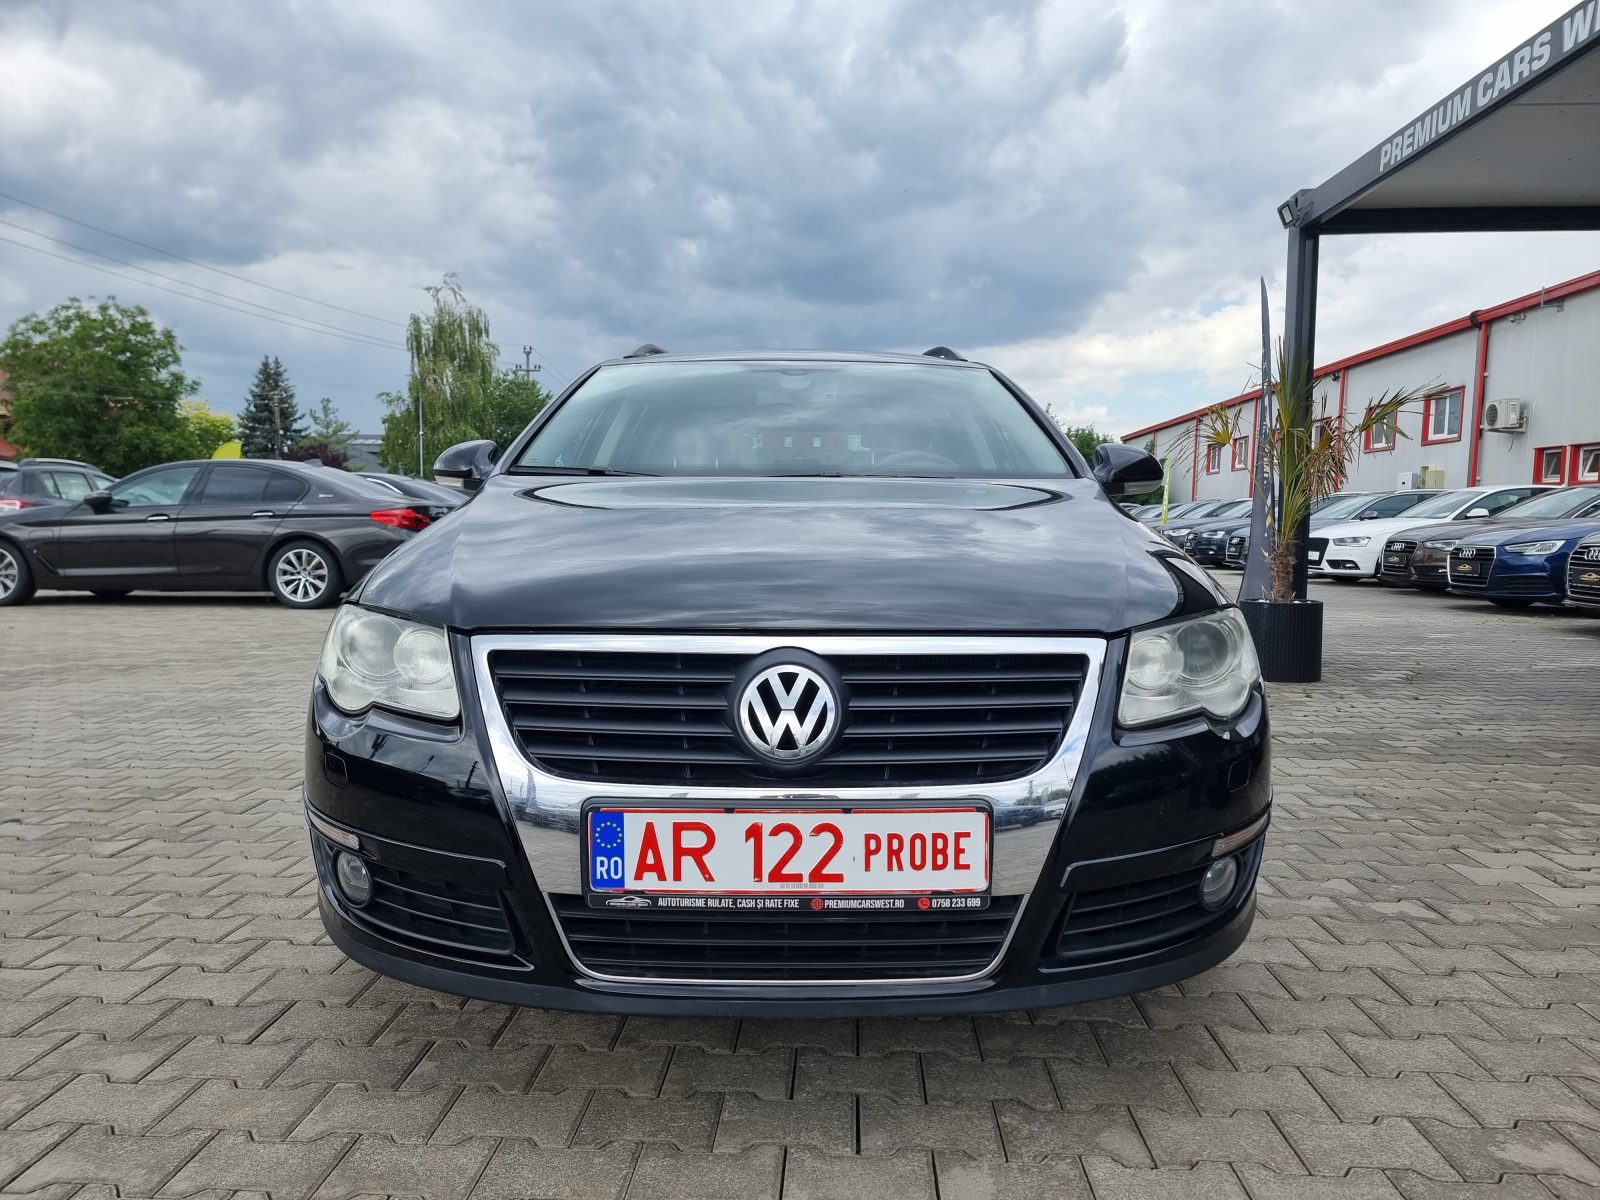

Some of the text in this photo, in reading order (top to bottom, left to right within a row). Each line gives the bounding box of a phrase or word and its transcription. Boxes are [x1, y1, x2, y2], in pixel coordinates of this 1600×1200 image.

[1380, 87, 1472, 172] PREMIUM
[1476, 31, 1552, 108] CARS
[634, 821, 972, 883] AR 122 PROBE
[596, 857, 623, 880] RO
[658, 898, 706, 908] AUTOTURISME
[707, 898, 736, 909] RULATE,
[737, 899, 756, 908] CASH
[765, 899, 783, 908] RATE
[784, 899, 800, 908] FIXE
[824, 899, 905, 909] PREMIUMCARSWEST.RO
[931, 897, 981, 908] 0758 233 699
